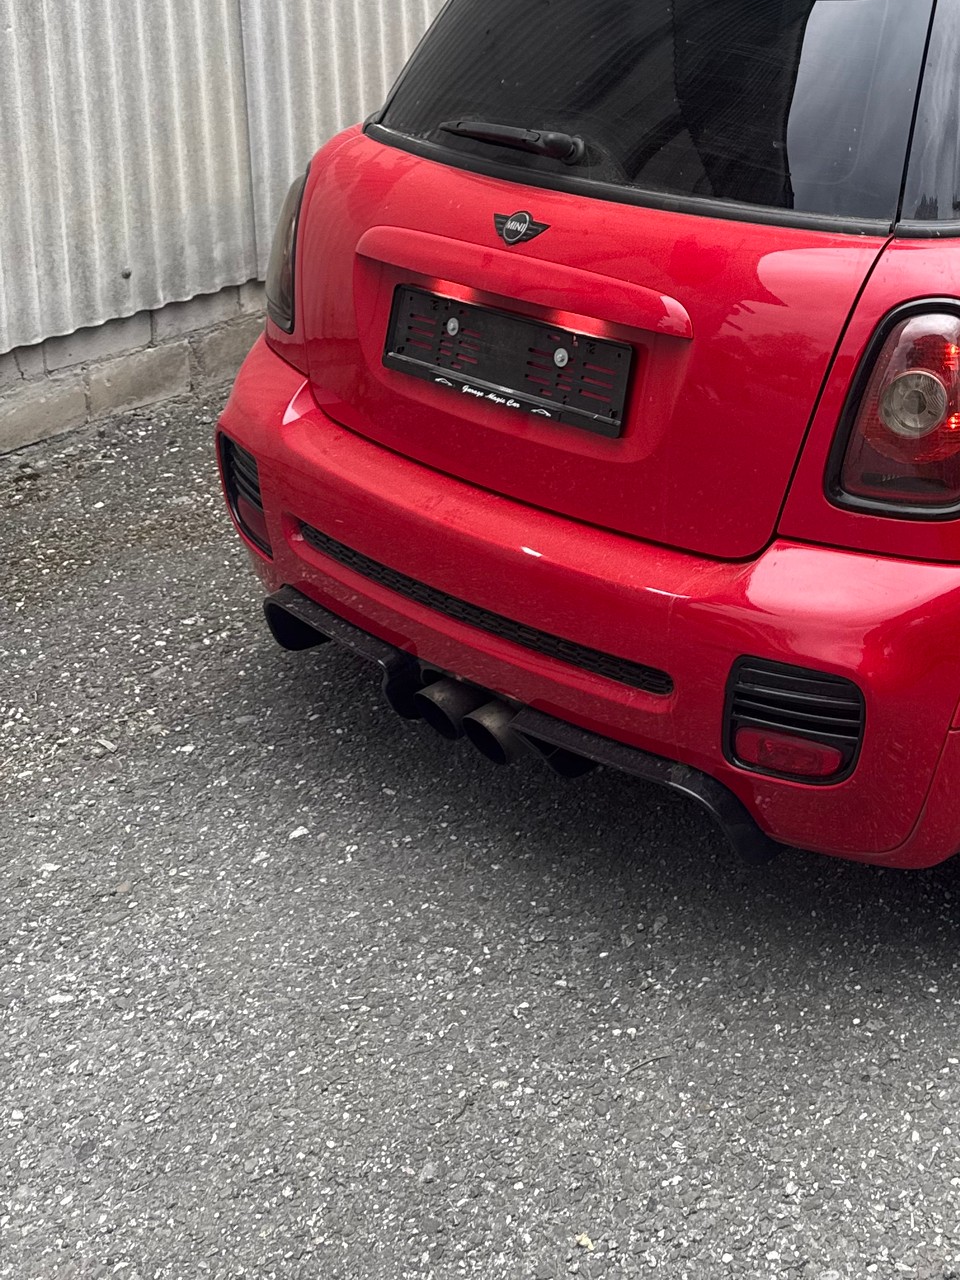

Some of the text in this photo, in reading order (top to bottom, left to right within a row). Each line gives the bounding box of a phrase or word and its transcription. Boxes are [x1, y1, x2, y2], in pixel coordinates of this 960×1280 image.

[506, 220, 527, 233] MINI
[462, 384, 520, 408] Garage Magic Car
